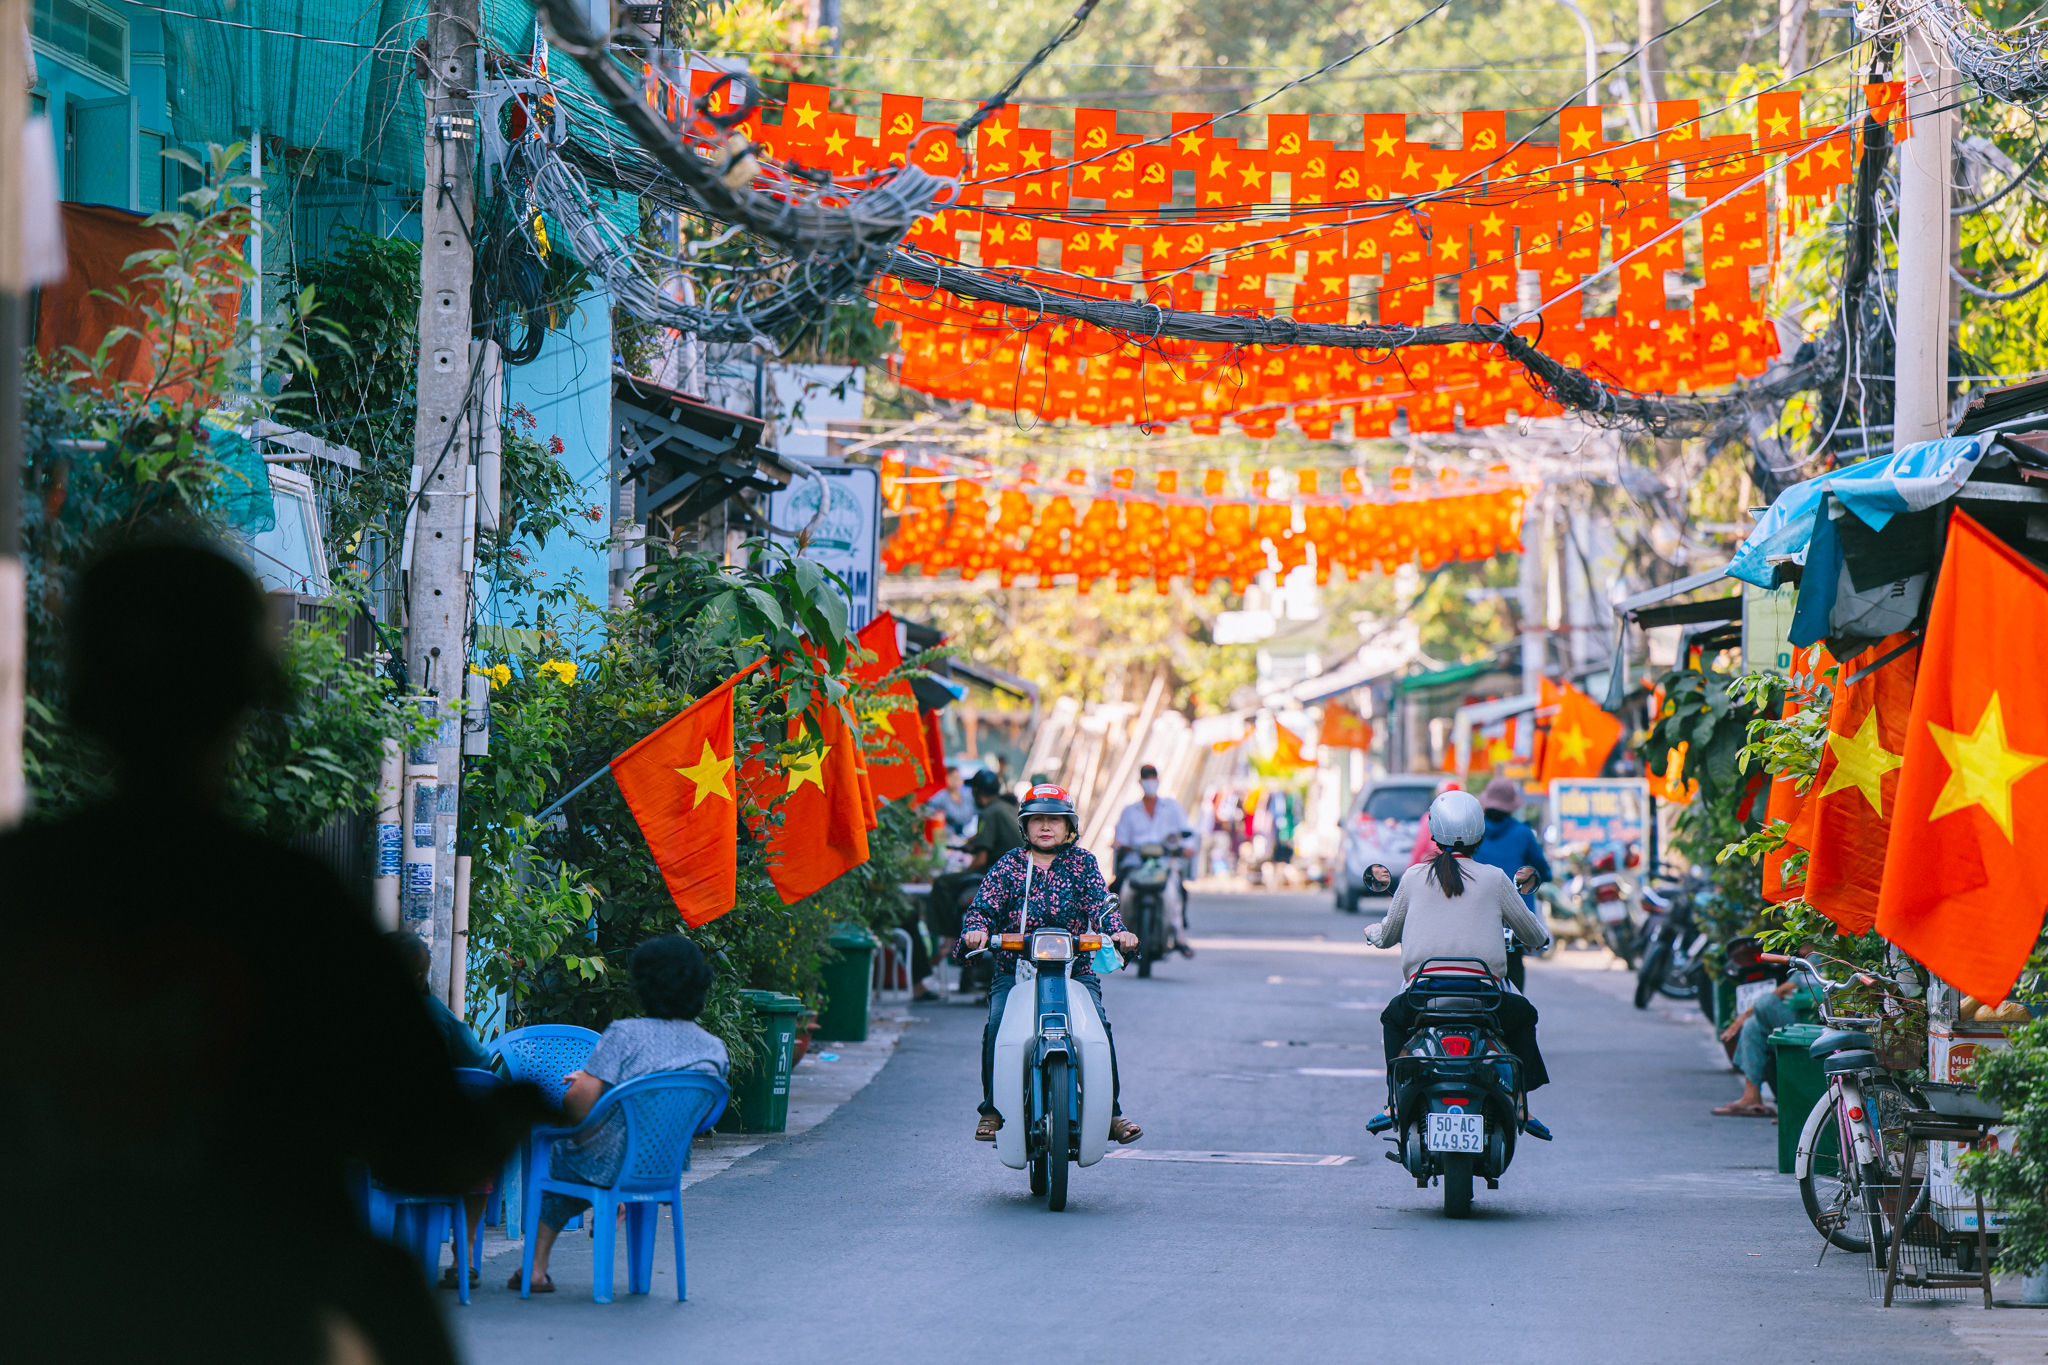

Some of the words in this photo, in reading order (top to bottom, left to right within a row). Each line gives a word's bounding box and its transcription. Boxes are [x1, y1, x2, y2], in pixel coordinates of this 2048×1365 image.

[1951, 1055, 1975, 1065] Mua
[1436, 1116, 1475, 1133] 50-AC
[1432, 1133, 1479, 1150] 449.52
